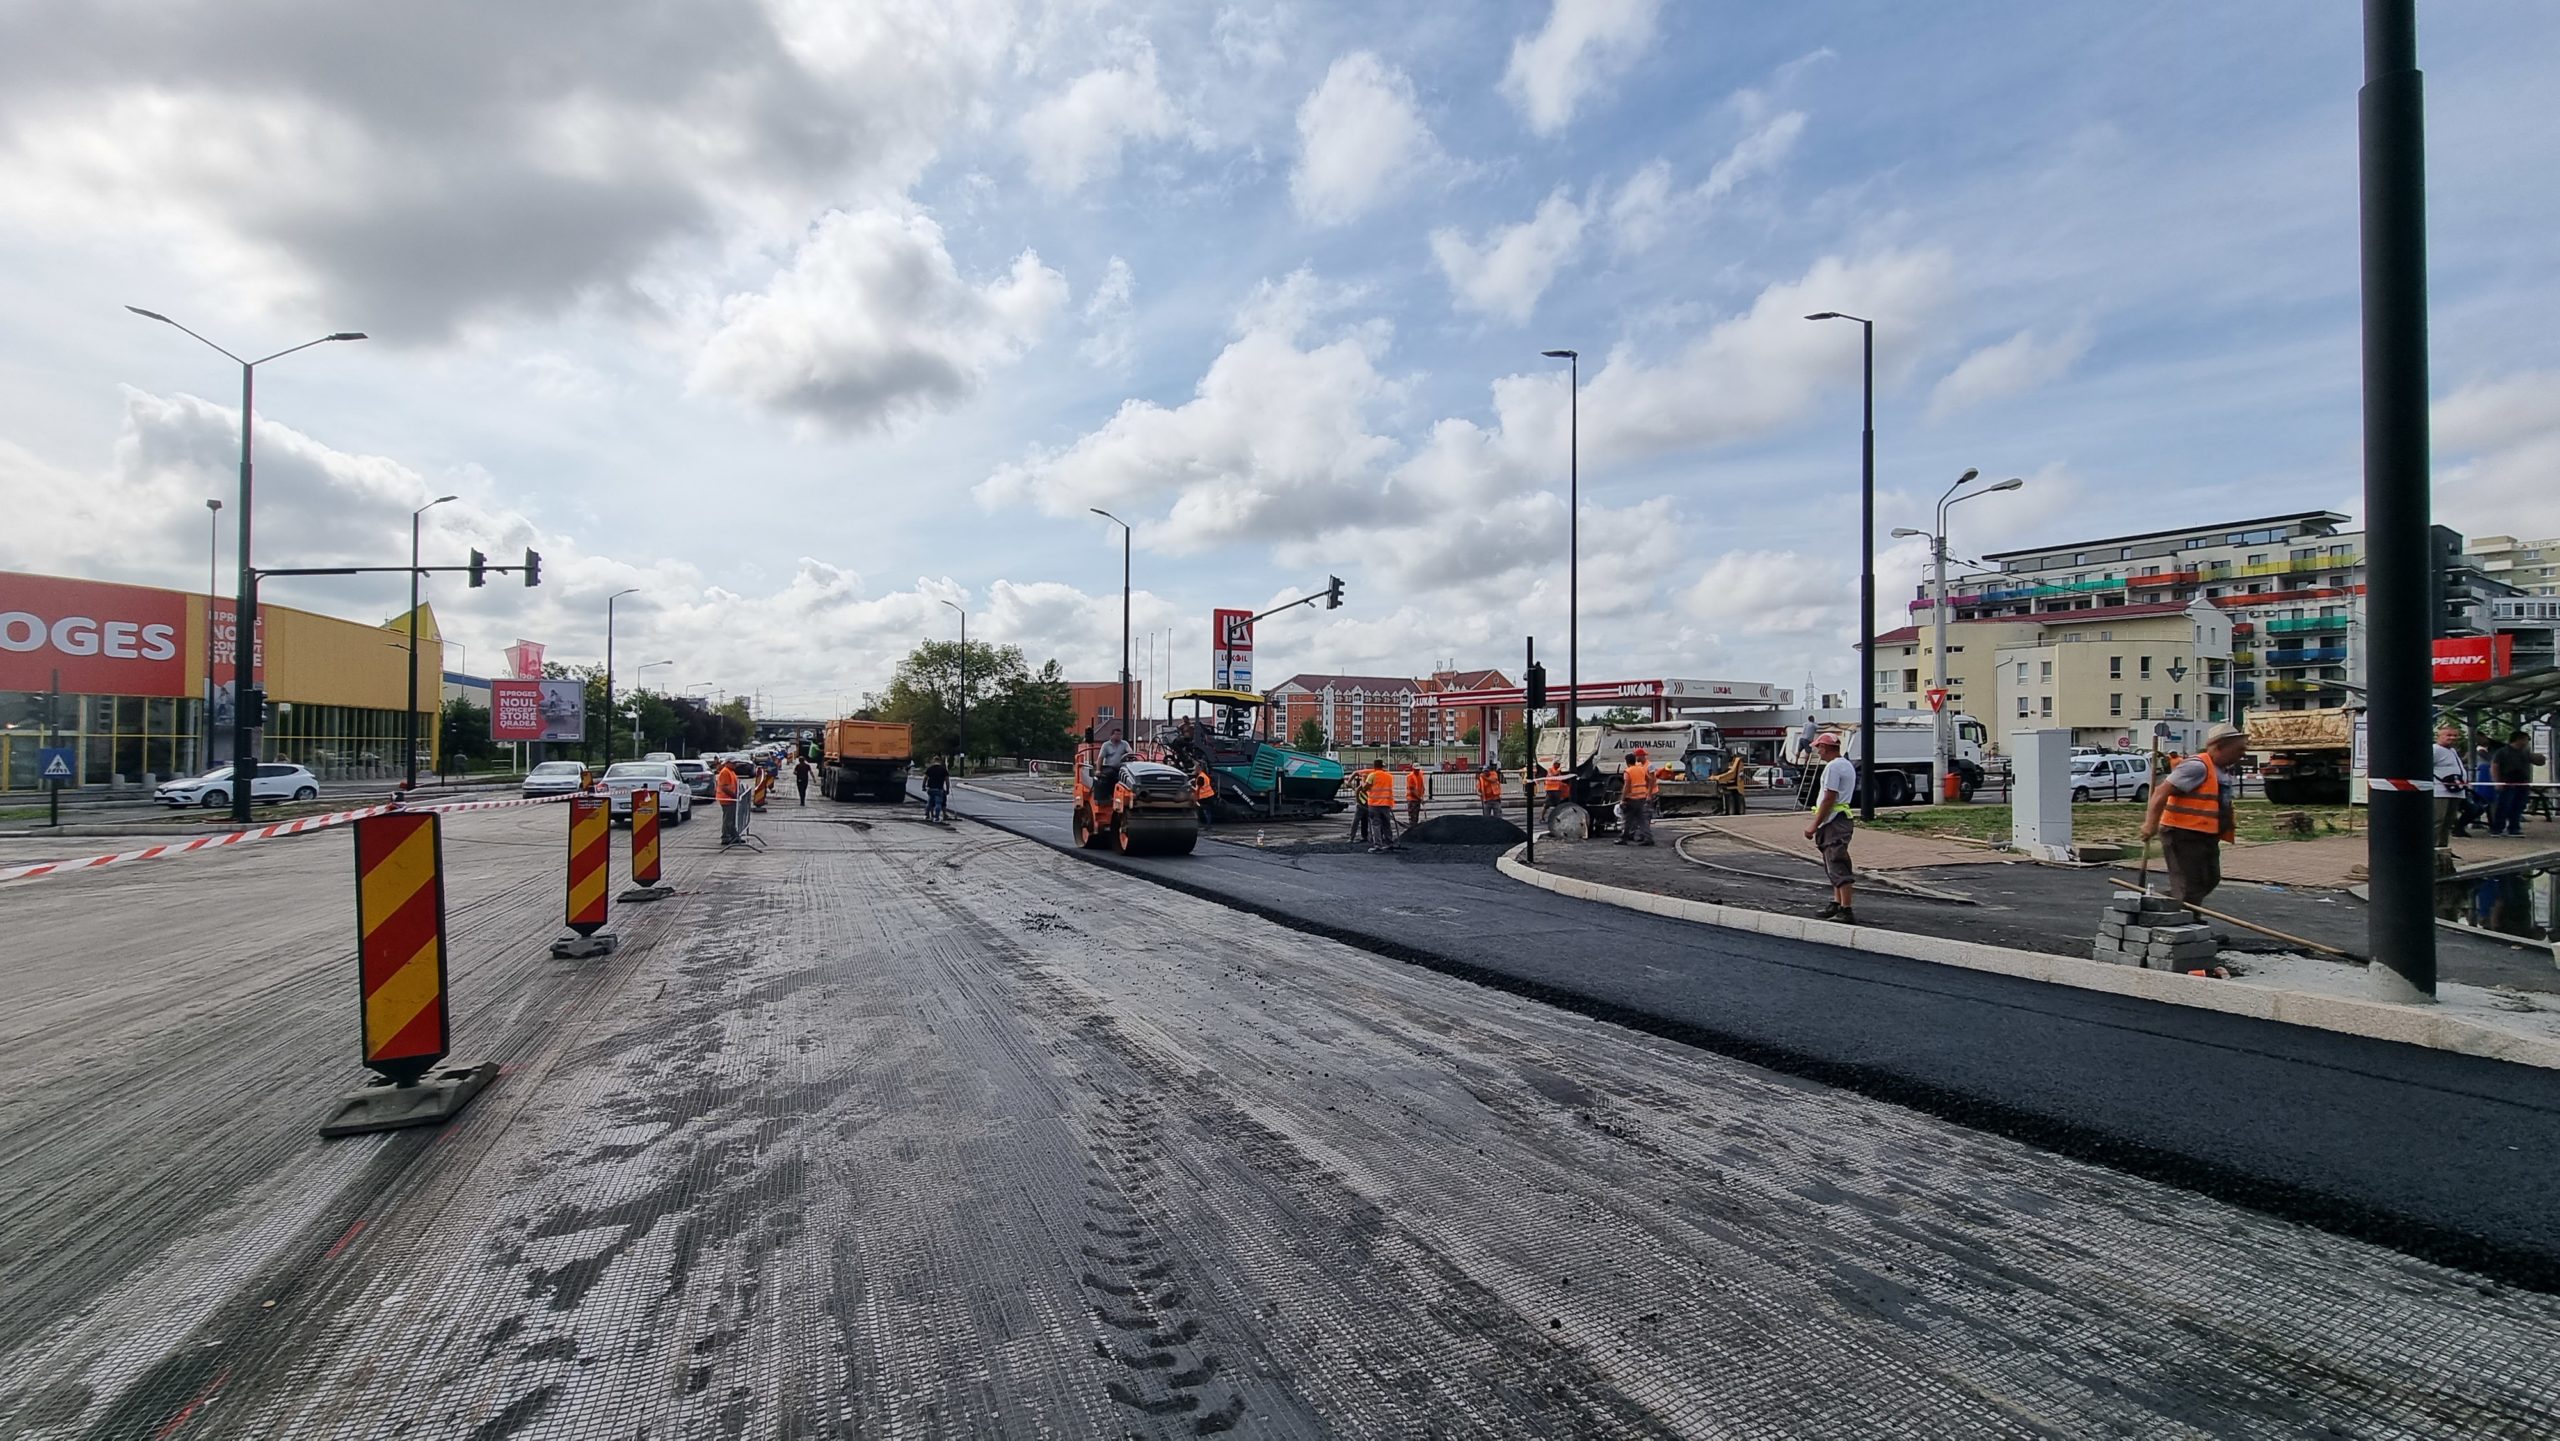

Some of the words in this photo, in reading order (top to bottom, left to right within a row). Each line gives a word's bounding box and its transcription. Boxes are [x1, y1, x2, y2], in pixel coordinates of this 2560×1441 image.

[1618, 682, 1655, 697] LUKOIL
[1712, 686, 1732, 695] LUKOIL
[500, 698, 537, 707] NOUL
[1415, 695, 1439, 707] LUKOIL
